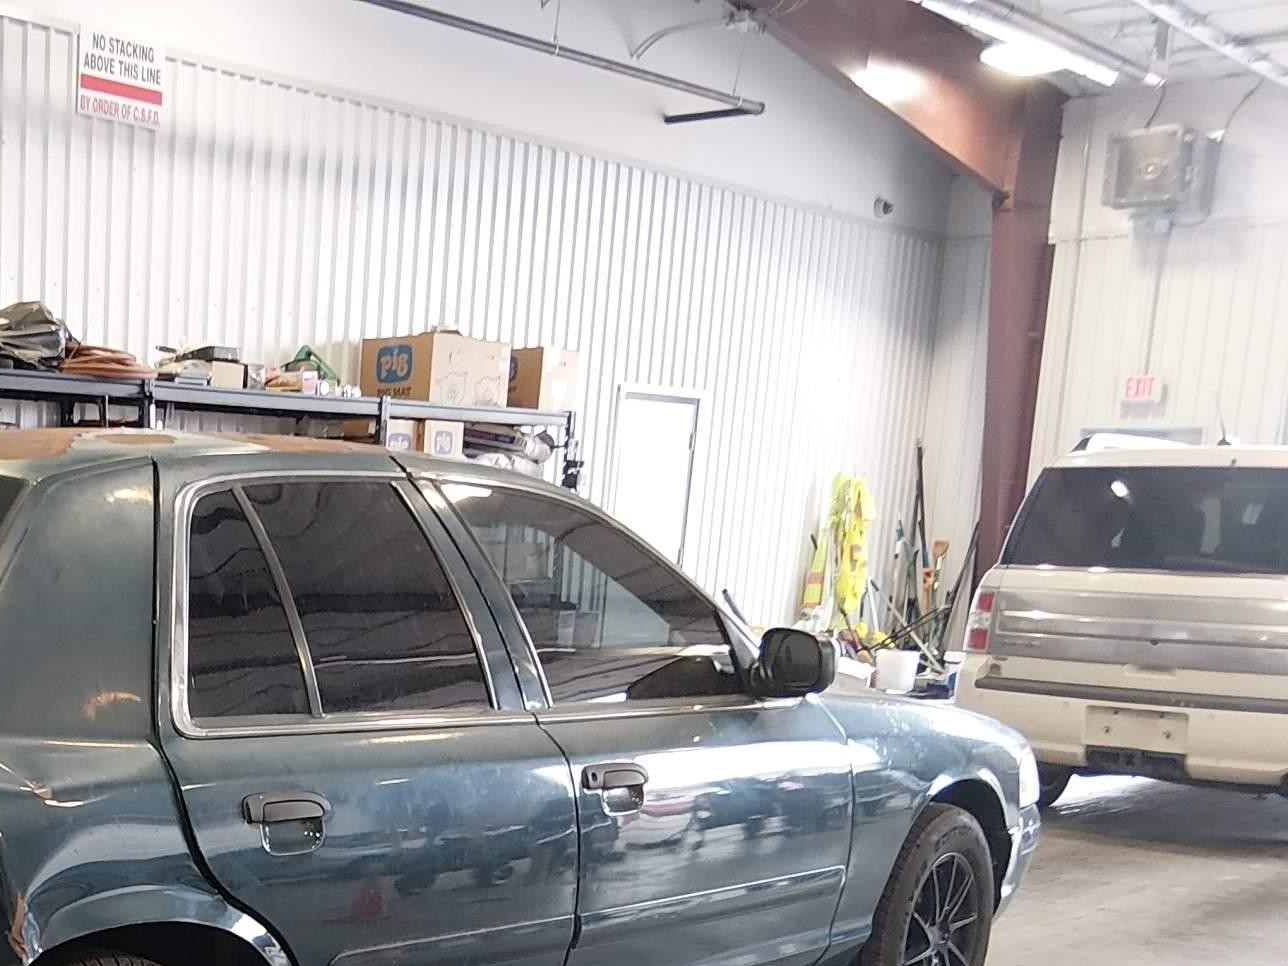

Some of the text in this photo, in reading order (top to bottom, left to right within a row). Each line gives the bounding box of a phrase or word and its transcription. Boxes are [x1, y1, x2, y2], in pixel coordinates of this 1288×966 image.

[92, 32, 154, 63] NO STACKING
[83, 52, 161, 85] ABOVE THIS LINE
[80, 95, 91, 112] BY
[92, 97, 120, 119] ORDER
[121, 104, 131, 120] OF
[380, 348, 409, 380] pig
[393, 387, 412, 398] MAT
[1125, 377, 1154, 399] EXIT
